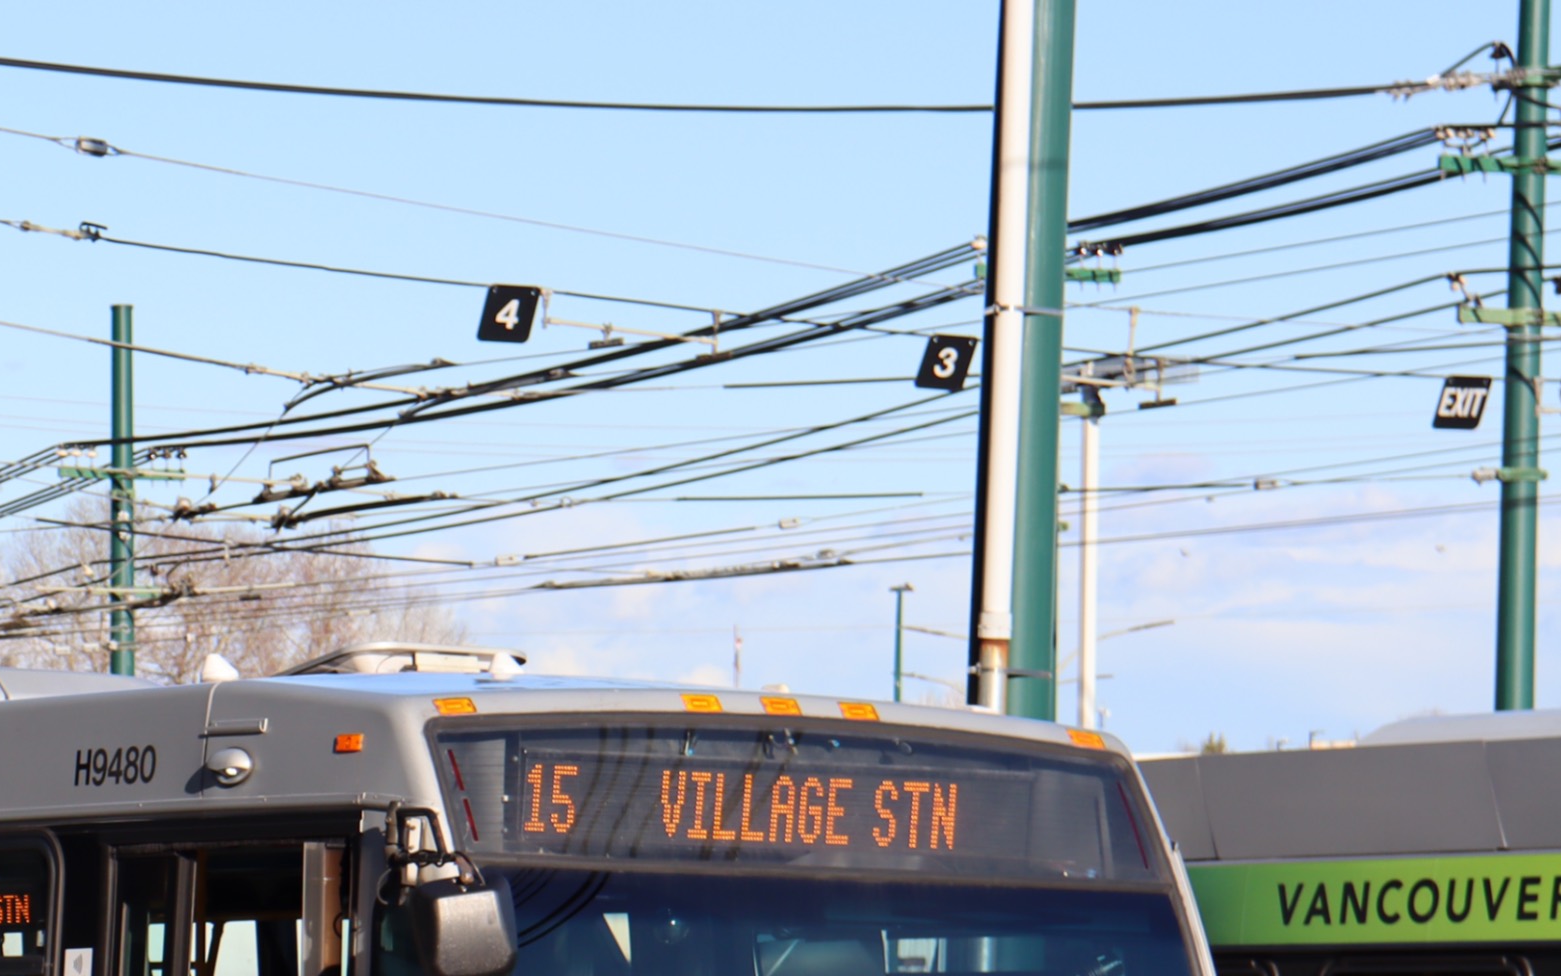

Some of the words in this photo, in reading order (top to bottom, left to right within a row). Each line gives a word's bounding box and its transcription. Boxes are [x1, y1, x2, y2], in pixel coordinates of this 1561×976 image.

[494, 298, 521, 330] 4
[932, 346, 959, 379] 3
[1438, 387, 1488, 418] EXIT
[73, 744, 157, 787] H9480
[523, 763, 579, 833] 15
[660, 769, 854, 846] VILLAGE
[872, 779, 958, 850] STN
